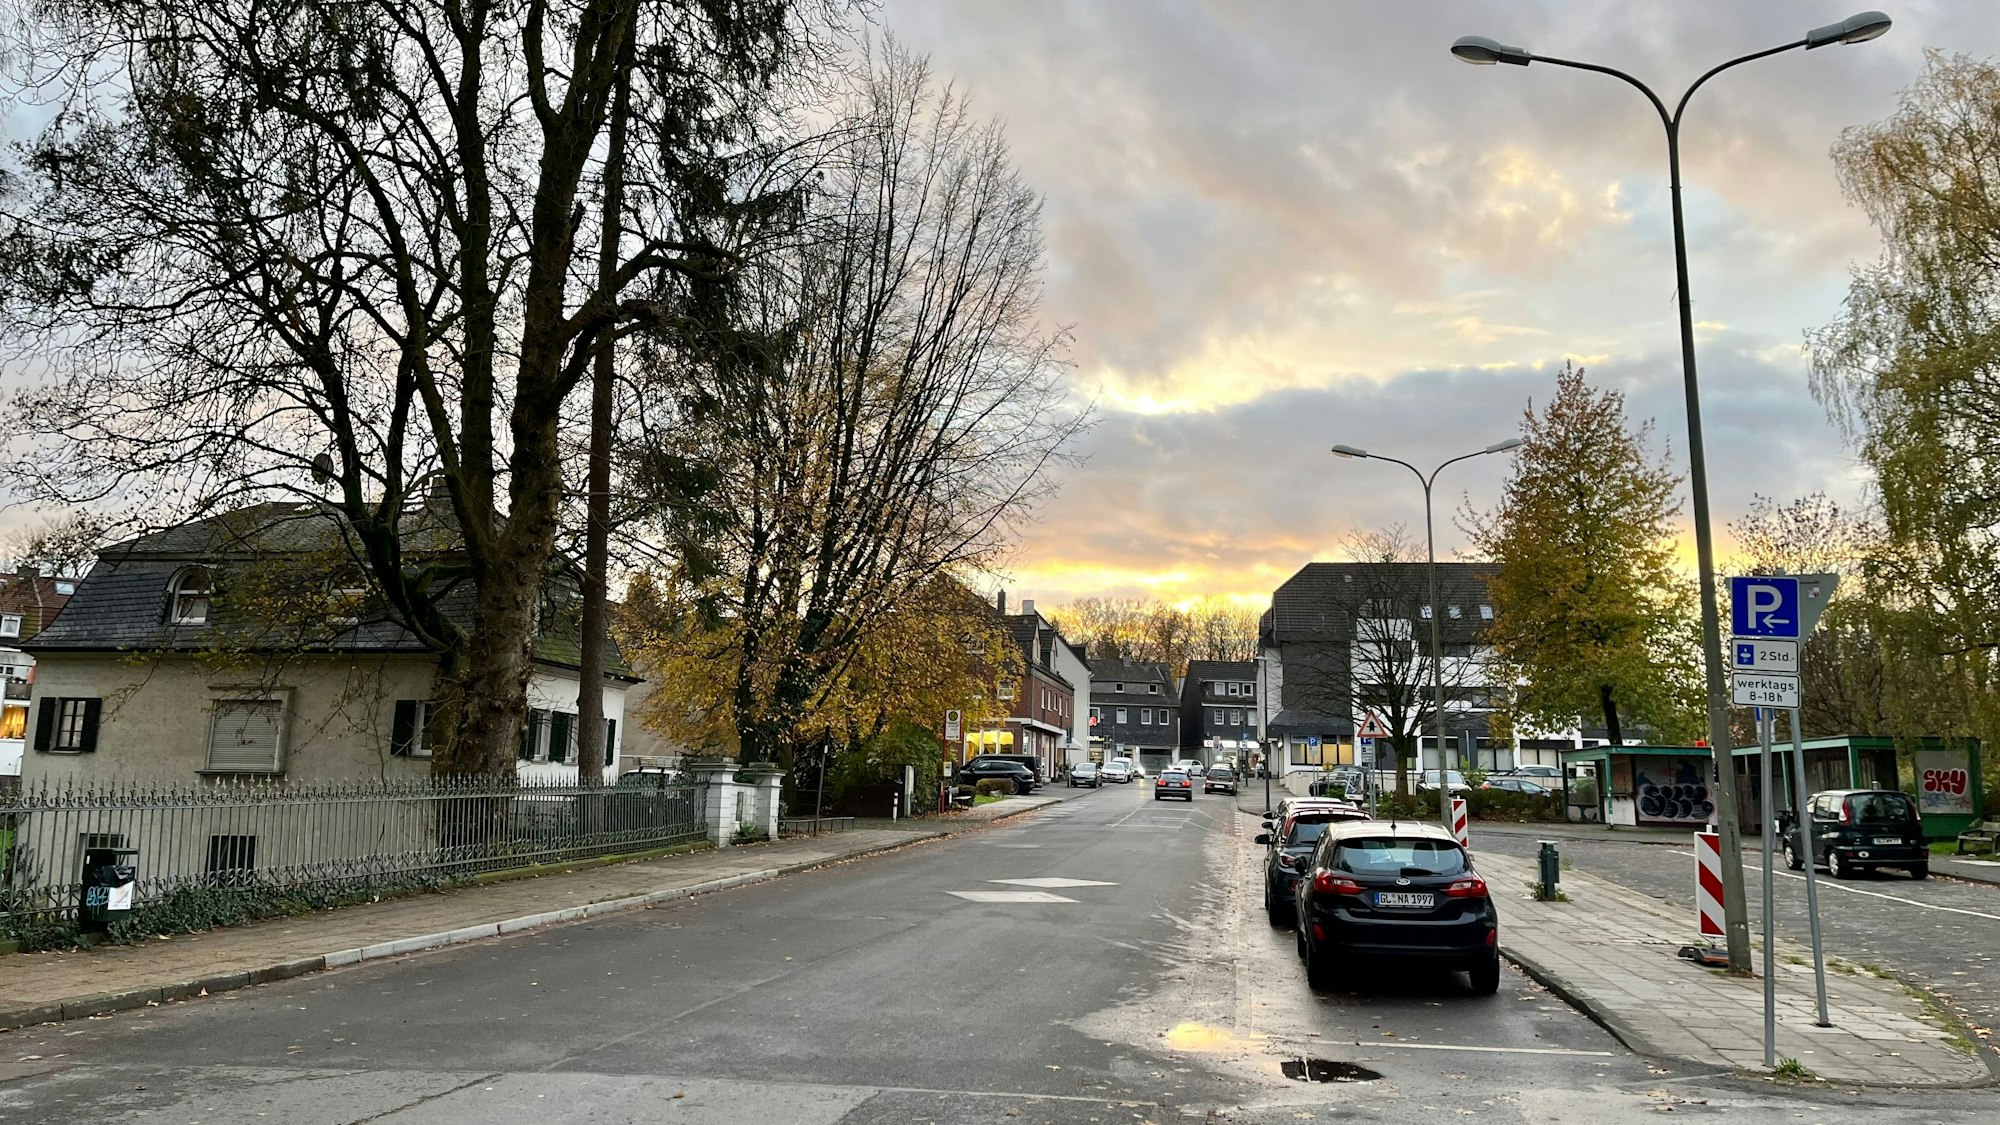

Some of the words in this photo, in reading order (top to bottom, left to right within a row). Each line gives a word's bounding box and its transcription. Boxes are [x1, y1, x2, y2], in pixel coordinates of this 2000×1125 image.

[1747, 584, 1783, 629] P
[1737, 679, 1795, 693] werktags
[1923, 768, 1968, 797] SKY
[1411, 894, 1433, 905] 1997
